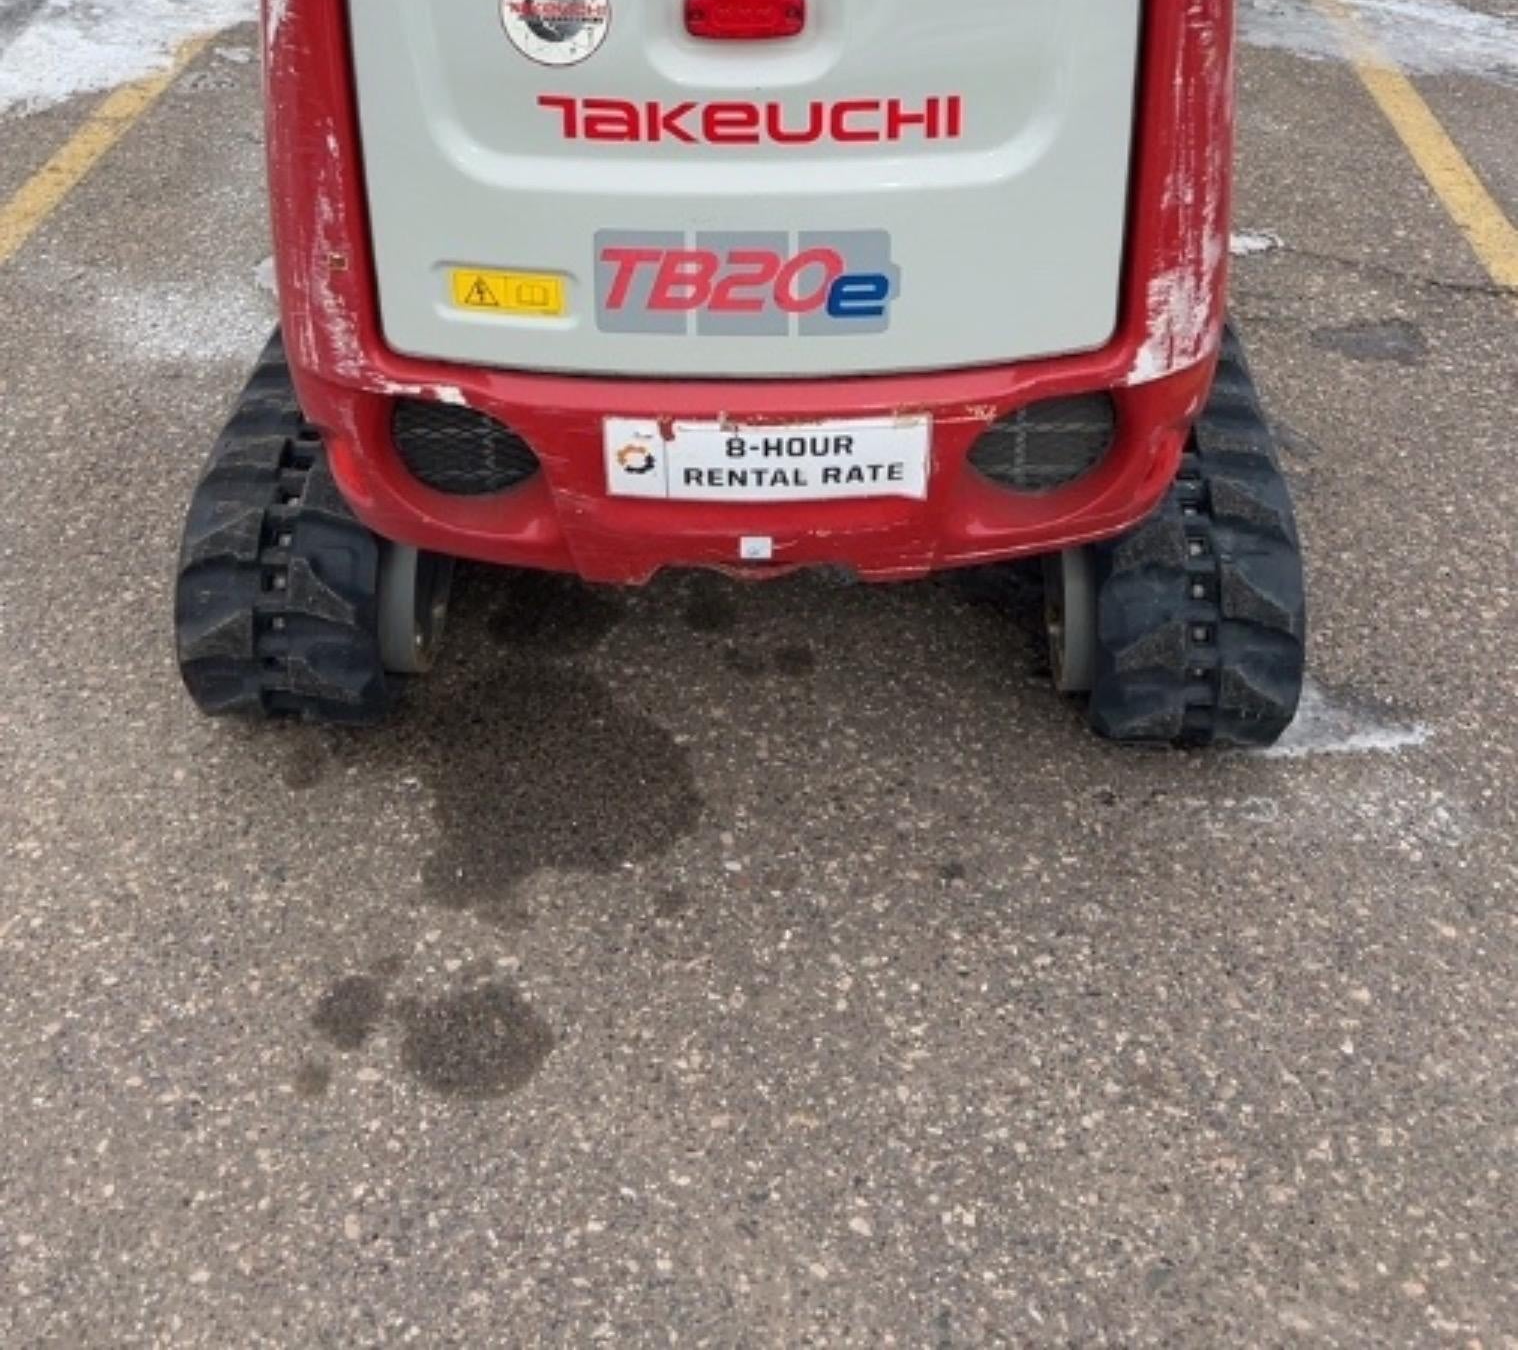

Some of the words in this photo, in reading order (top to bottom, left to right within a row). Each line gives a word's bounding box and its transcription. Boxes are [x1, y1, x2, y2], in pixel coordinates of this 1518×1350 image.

[599, 247, 890, 318] TB20e
[725, 436, 854, 458] 8-HOUR
[683, 466, 807, 487] RENTAL
[821, 462, 904, 484] RATE
